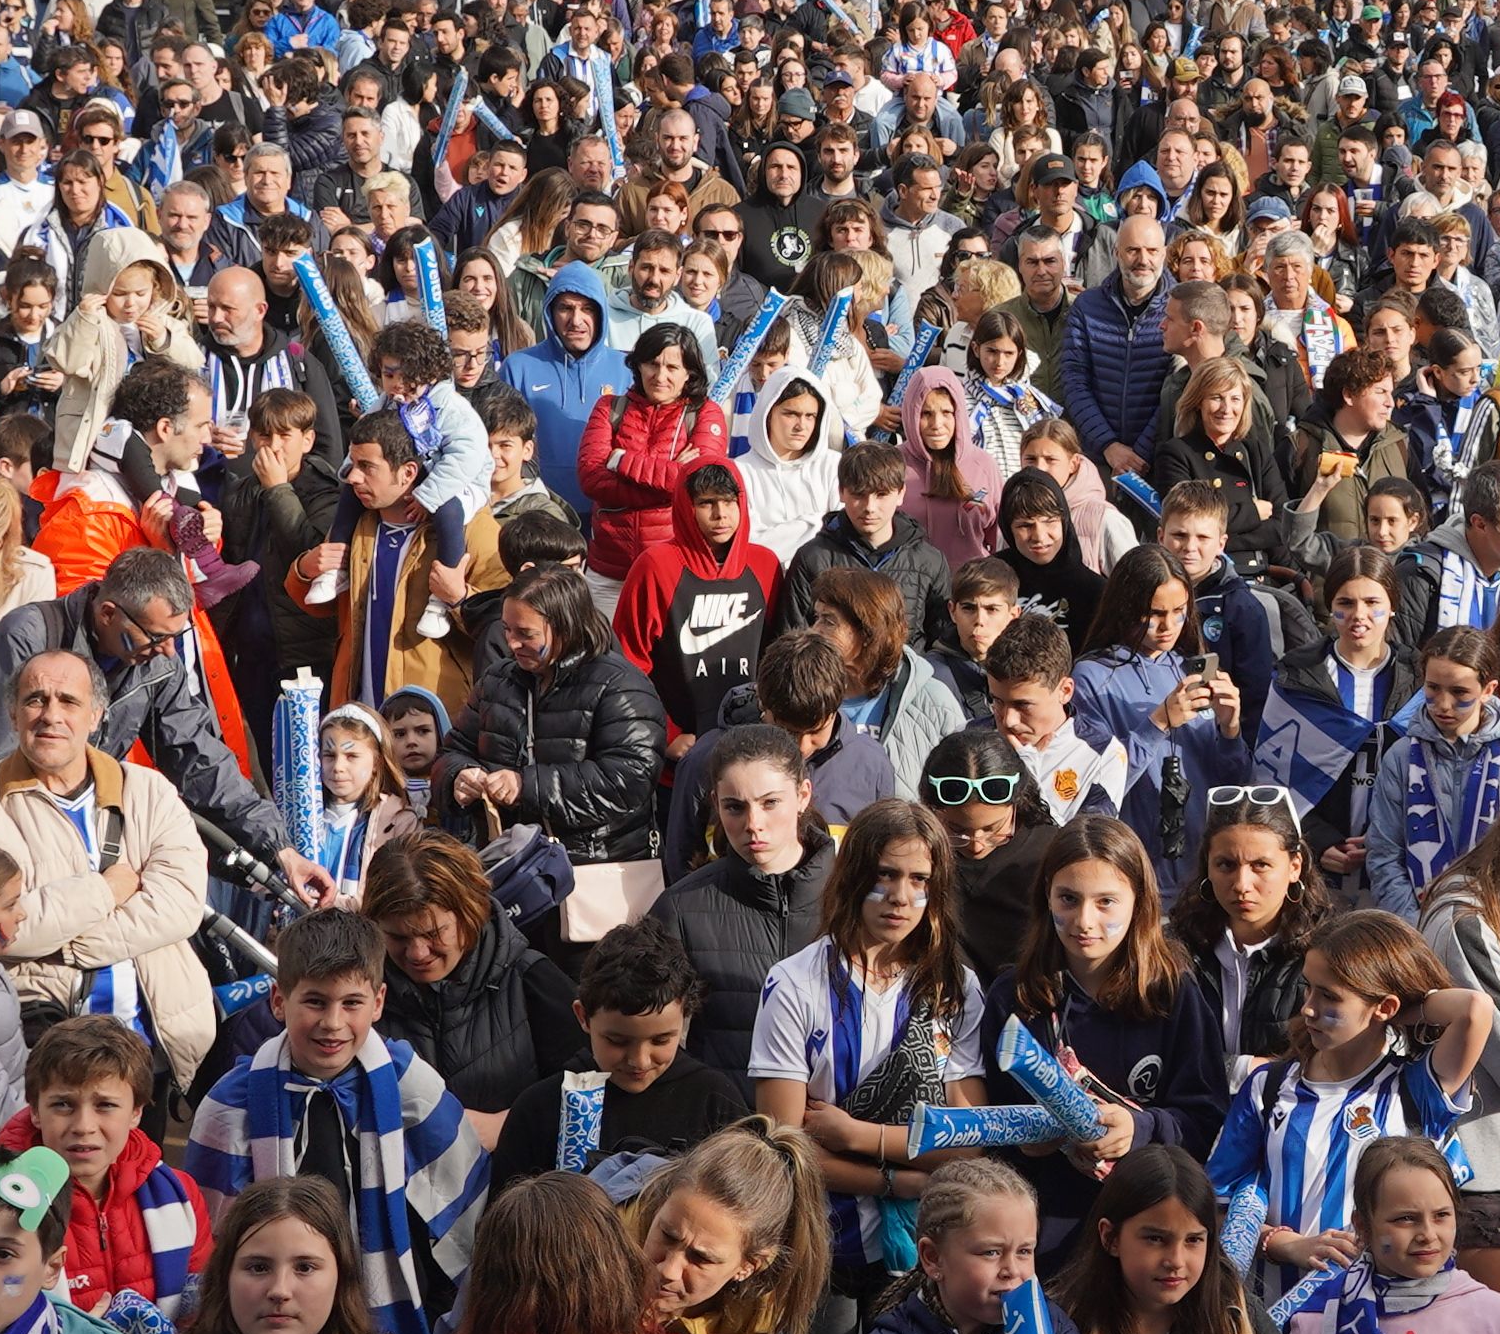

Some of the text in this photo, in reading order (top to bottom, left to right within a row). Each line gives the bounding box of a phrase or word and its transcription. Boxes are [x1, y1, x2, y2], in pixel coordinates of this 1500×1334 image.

[311, 277, 334, 311] eitb
[915, 328, 934, 357] eitb
[690, 592, 749, 629] NIKE
[1036, 1064, 1058, 1090] eitb
[953, 1128, 982, 1149] eitb
